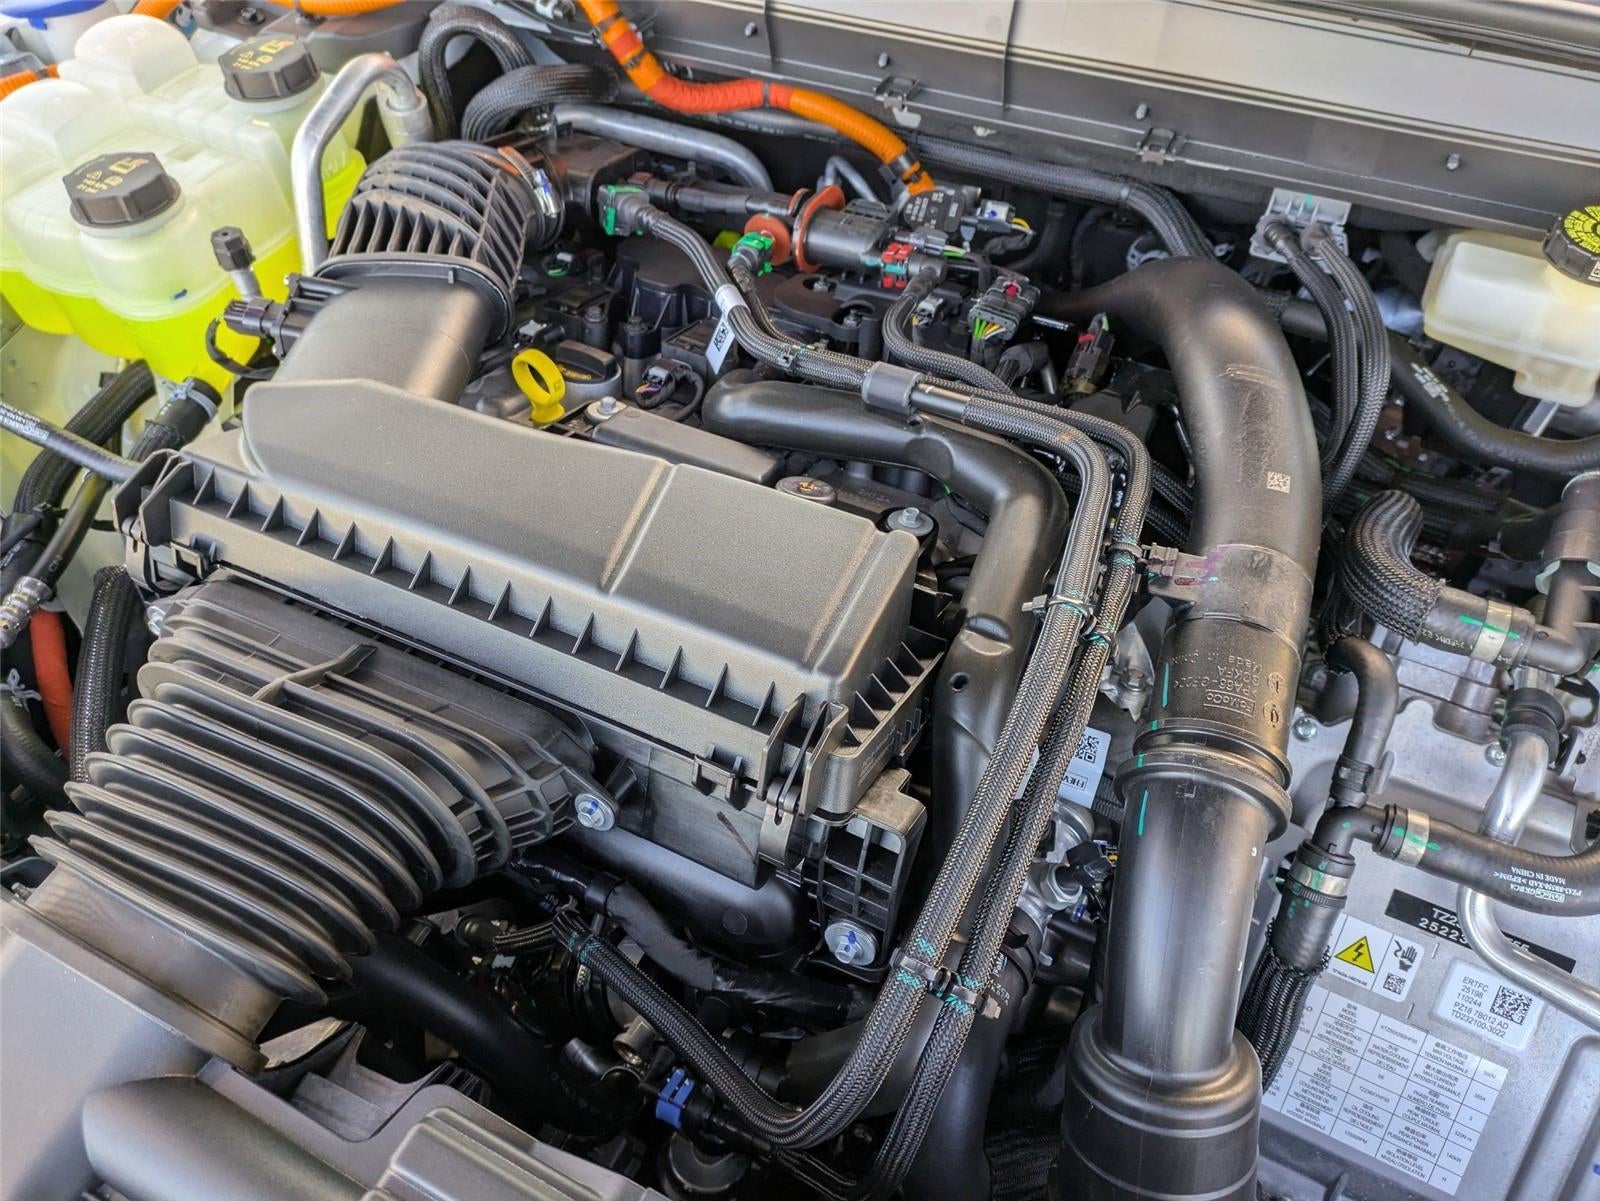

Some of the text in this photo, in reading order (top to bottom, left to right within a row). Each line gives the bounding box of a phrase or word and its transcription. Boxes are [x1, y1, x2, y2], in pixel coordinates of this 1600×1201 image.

[1207, 692, 1254, 713] FoMoCo
[1511, 866, 1534, 877] CHINA
[1545, 876, 1566, 885] MADE
[1462, 976, 1489, 992] ERTFC
[1461, 985, 1484, 999] 25198
[1458, 993, 1482, 1007] 110244
[1452, 1009, 1506, 1038] TD232100-3022
[1497, 1021, 1509, 1030] AD
